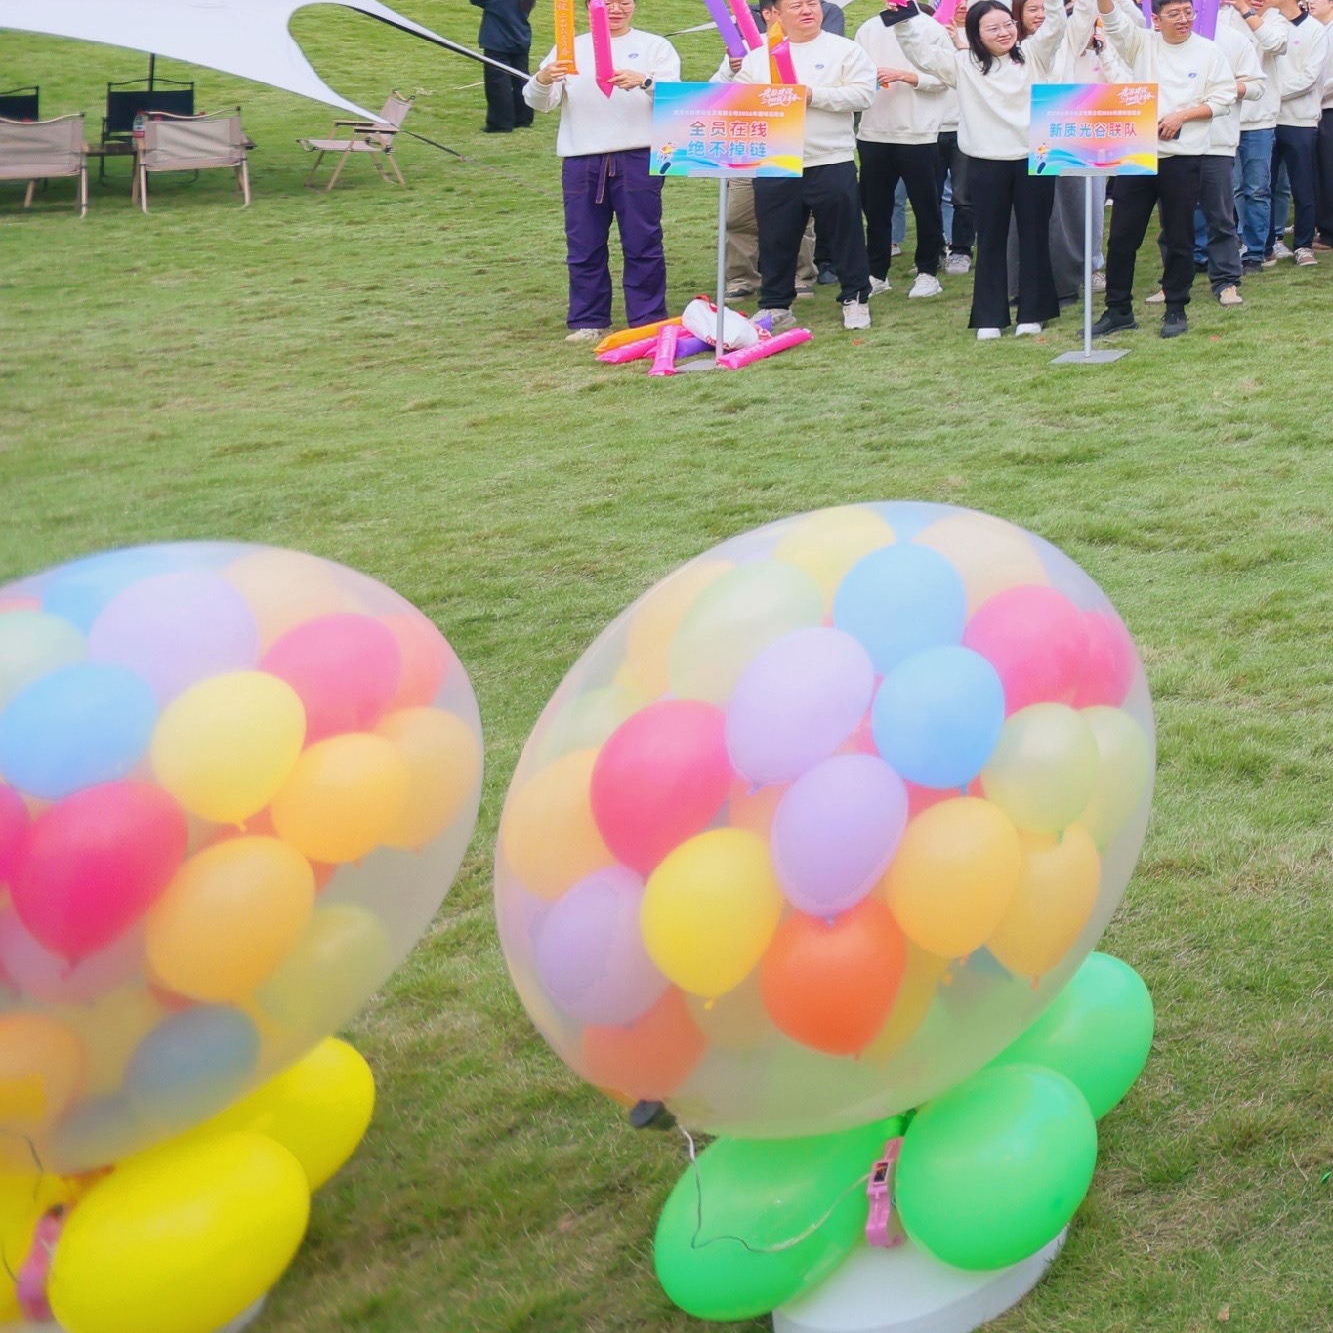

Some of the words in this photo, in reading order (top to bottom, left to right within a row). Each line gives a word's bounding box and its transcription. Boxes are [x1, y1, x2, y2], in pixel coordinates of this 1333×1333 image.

[689, 121, 768, 137] 全员在线
[1049, 123, 1137, 137] 新质光谷联队
[687, 141, 767, 157] 绝不掉链
